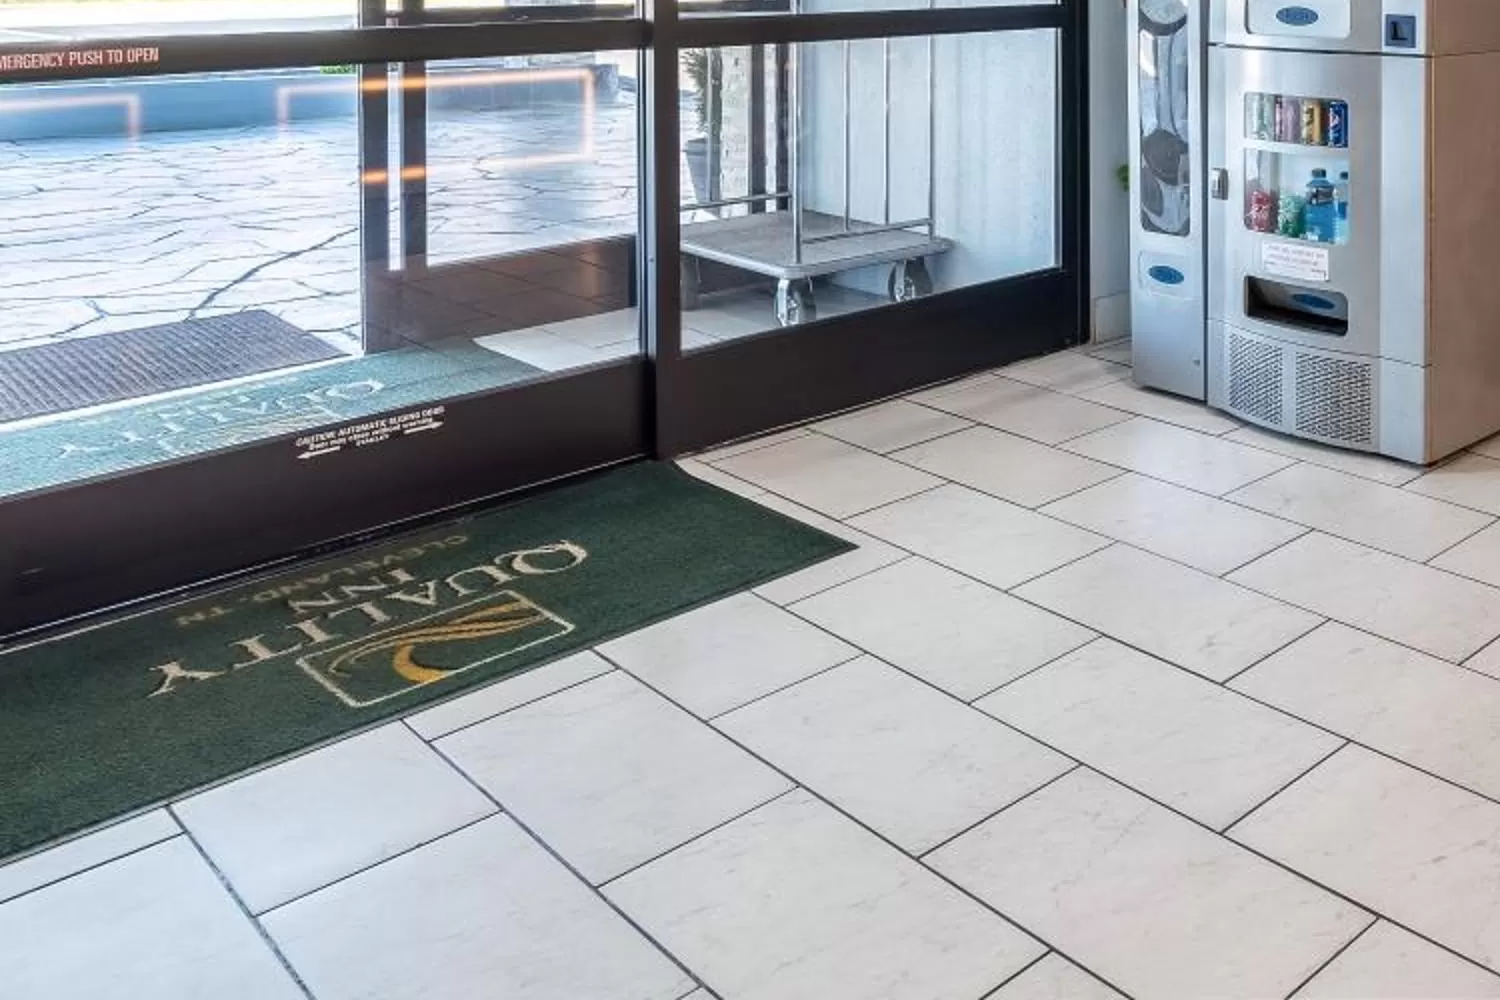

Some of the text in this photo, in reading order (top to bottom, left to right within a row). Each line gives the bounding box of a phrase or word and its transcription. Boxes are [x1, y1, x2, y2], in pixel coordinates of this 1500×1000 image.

[69, 49, 103, 66] PUSH
[107, 49, 123, 64] TO
[127, 47, 160, 63] OPEN
[288, 568, 416, 613] INN
[147, 540, 588, 697] QUALITY
